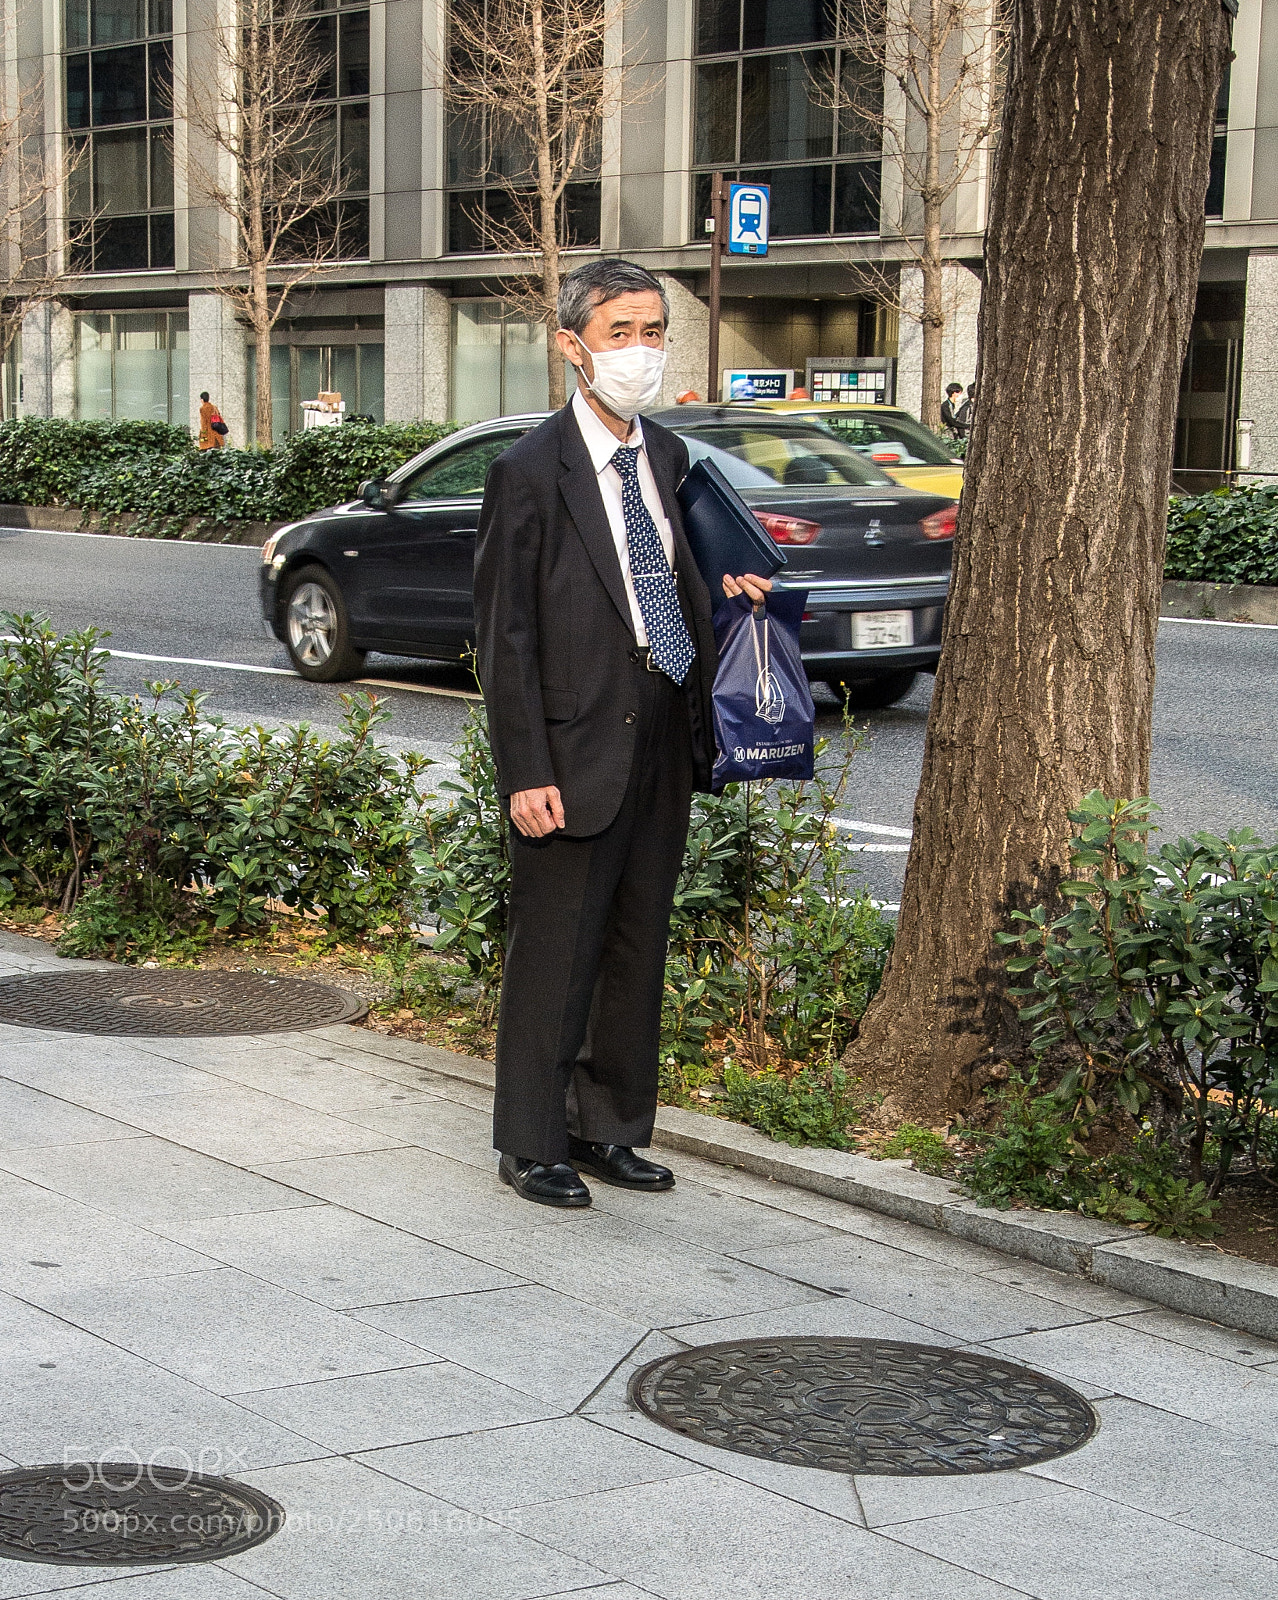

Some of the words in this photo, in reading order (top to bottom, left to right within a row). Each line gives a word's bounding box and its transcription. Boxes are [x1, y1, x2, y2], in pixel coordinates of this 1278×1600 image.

[753, 379, 780, 388] 東京メトロ
[746, 743, 805, 760] MARUZEN
